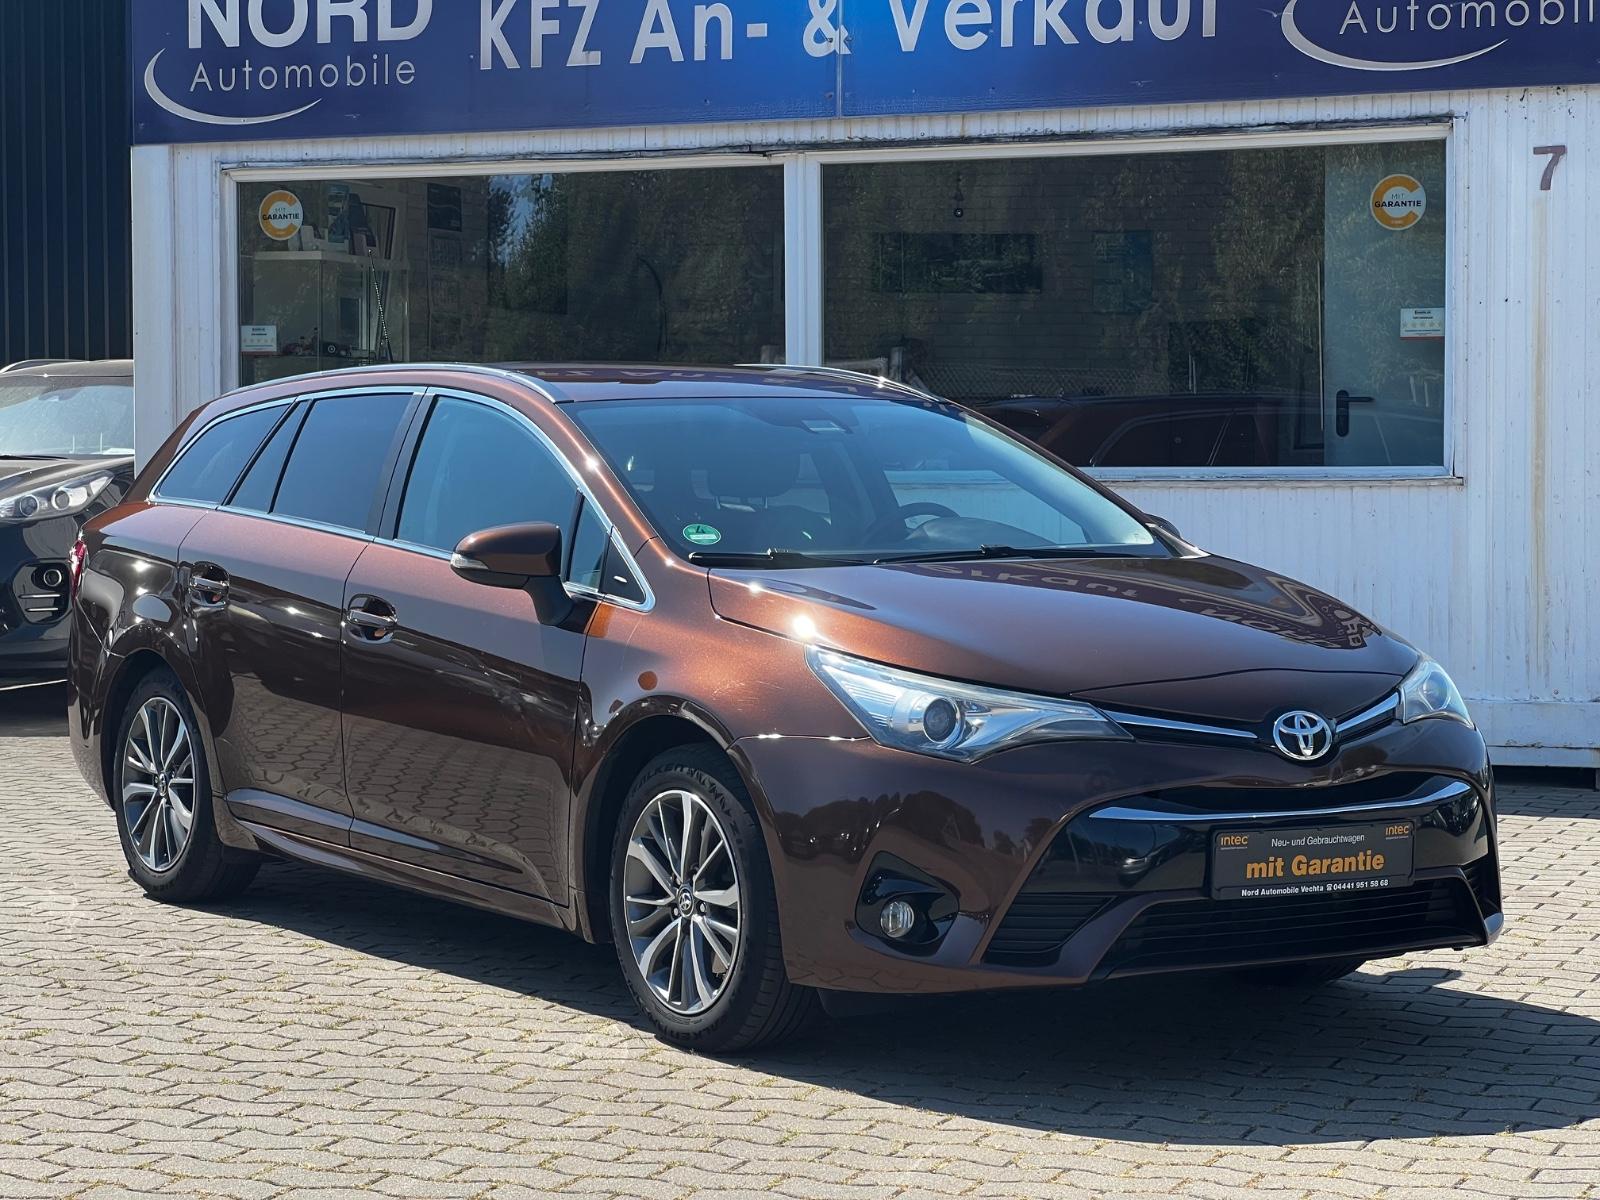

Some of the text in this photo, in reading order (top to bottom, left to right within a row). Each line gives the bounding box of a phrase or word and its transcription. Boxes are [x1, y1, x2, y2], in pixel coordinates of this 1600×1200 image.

[188, 0, 433, 49] NORD
[480, 0, 601, 70] KFZ
[629, 0, 768, 64] An-
[802, 0, 852, 58] &
[190, 53, 415, 92] Automobile
[1533, 145, 1565, 190] 7
[262, 213, 300, 221] GARANTIE
[1374, 200, 1422, 208] GARANTIE
[1271, 834, 1365, 847] Neu- und Gebrauchtwagen
[1246, 849, 1385, 878] mit Garantie
[1260, 886, 1299, 895] Automobile
[1300, 885, 1324, 893] Vechta
[1333, 882, 1355, 891] 04441
[1356, 881, 1368, 889] 951
